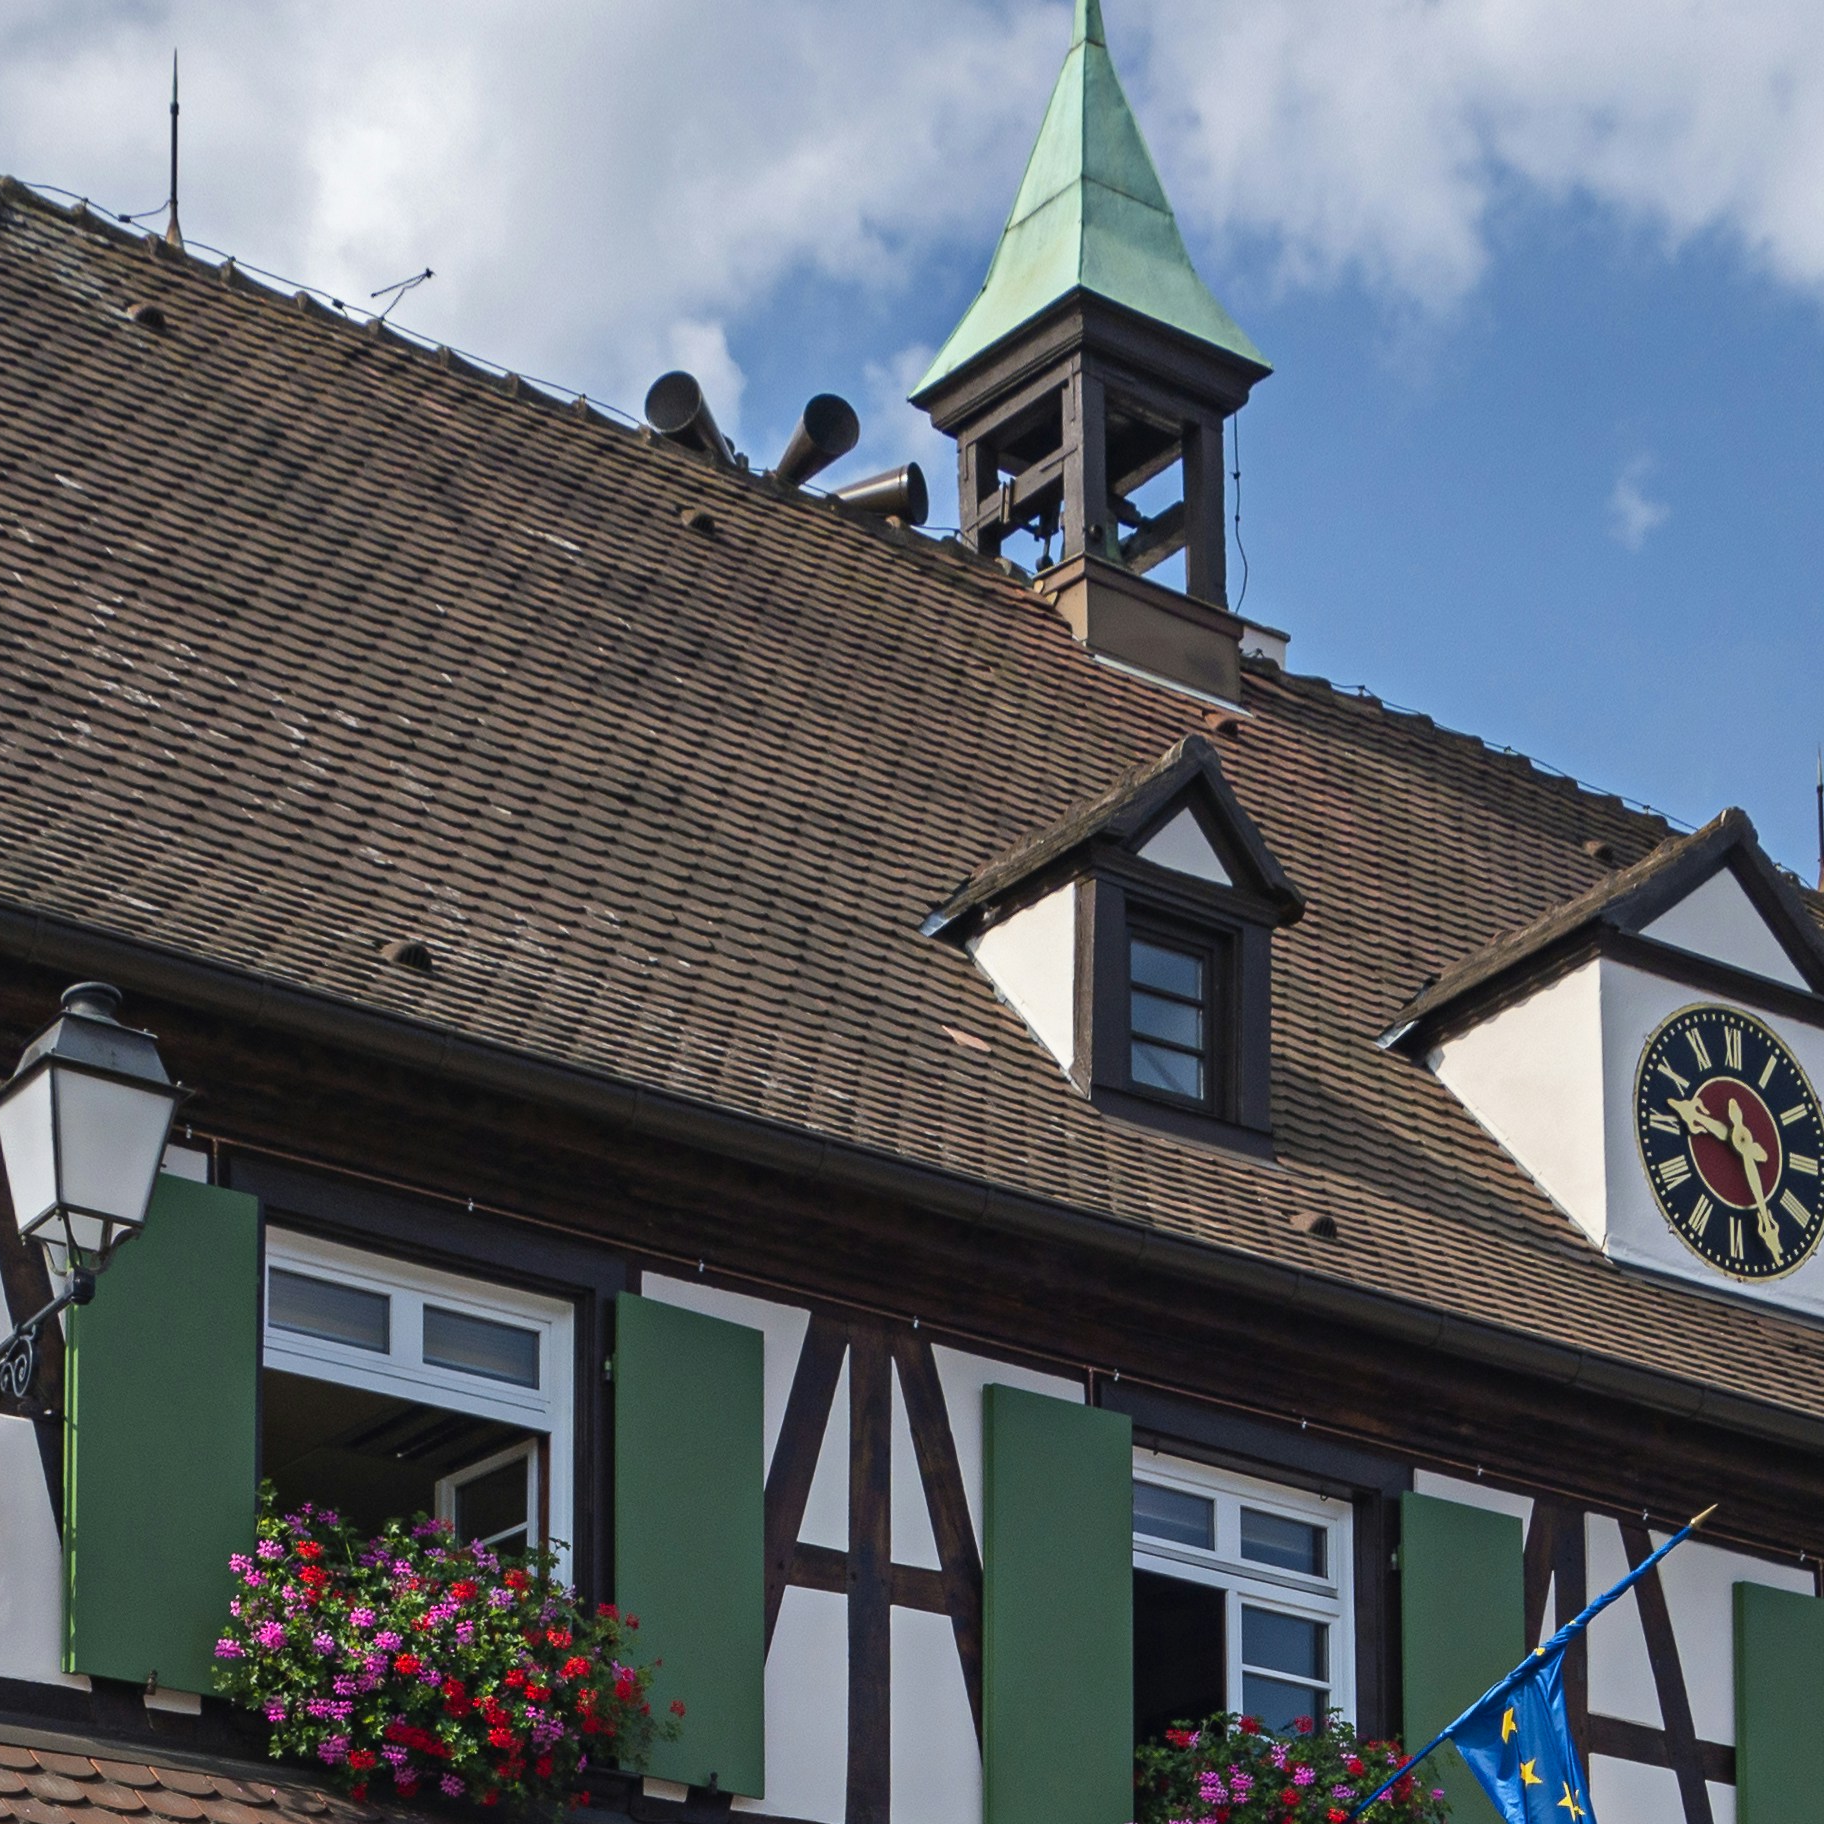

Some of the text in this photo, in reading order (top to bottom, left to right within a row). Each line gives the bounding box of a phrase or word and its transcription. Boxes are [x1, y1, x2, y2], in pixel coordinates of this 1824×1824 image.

[1725, 1026, 1742, 1071] XII
[1657, 1056, 1690, 1097] X
[1789, 1152, 1819, 1176] III
